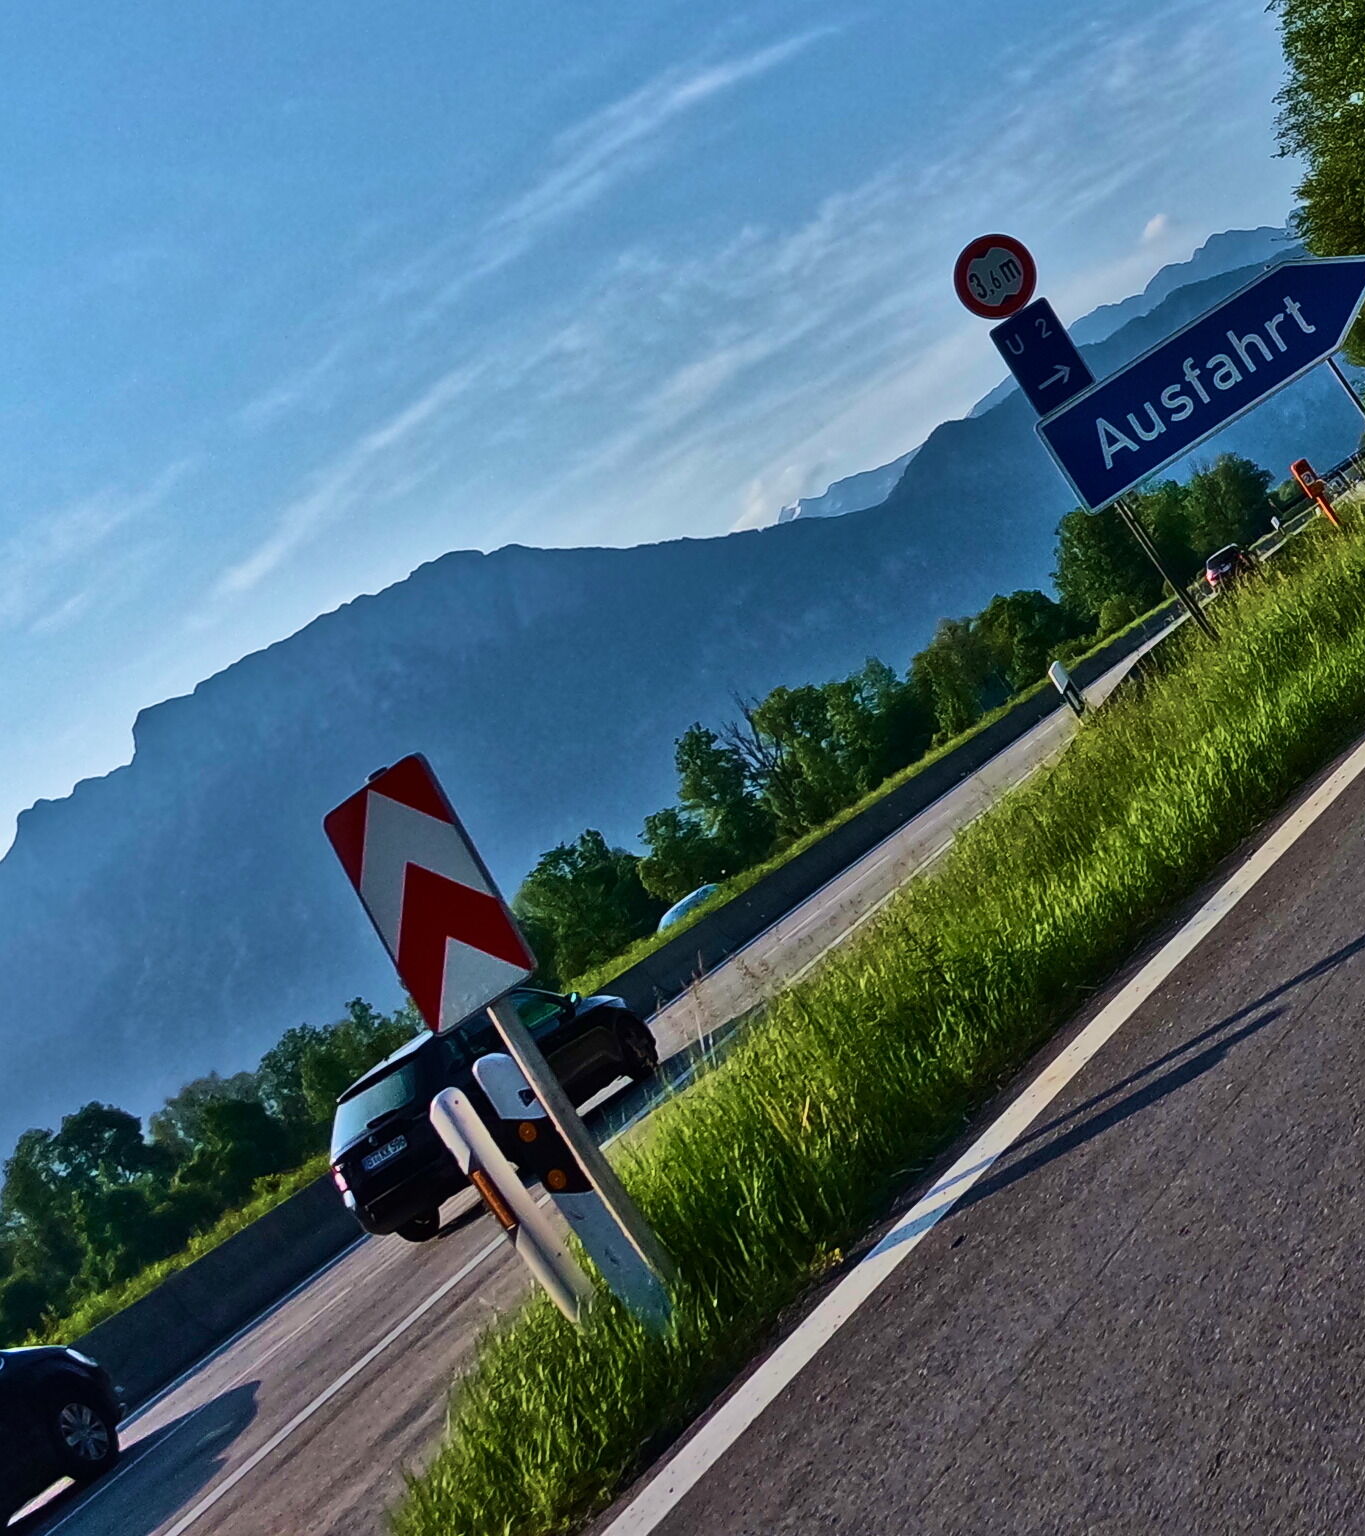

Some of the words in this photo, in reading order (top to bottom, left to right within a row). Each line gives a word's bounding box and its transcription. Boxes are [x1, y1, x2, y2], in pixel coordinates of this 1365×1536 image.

[1005, 333, 1024, 355] U
[1035, 318, 1052, 338] 2
[1096, 296, 1316, 470] Ausfahrt
